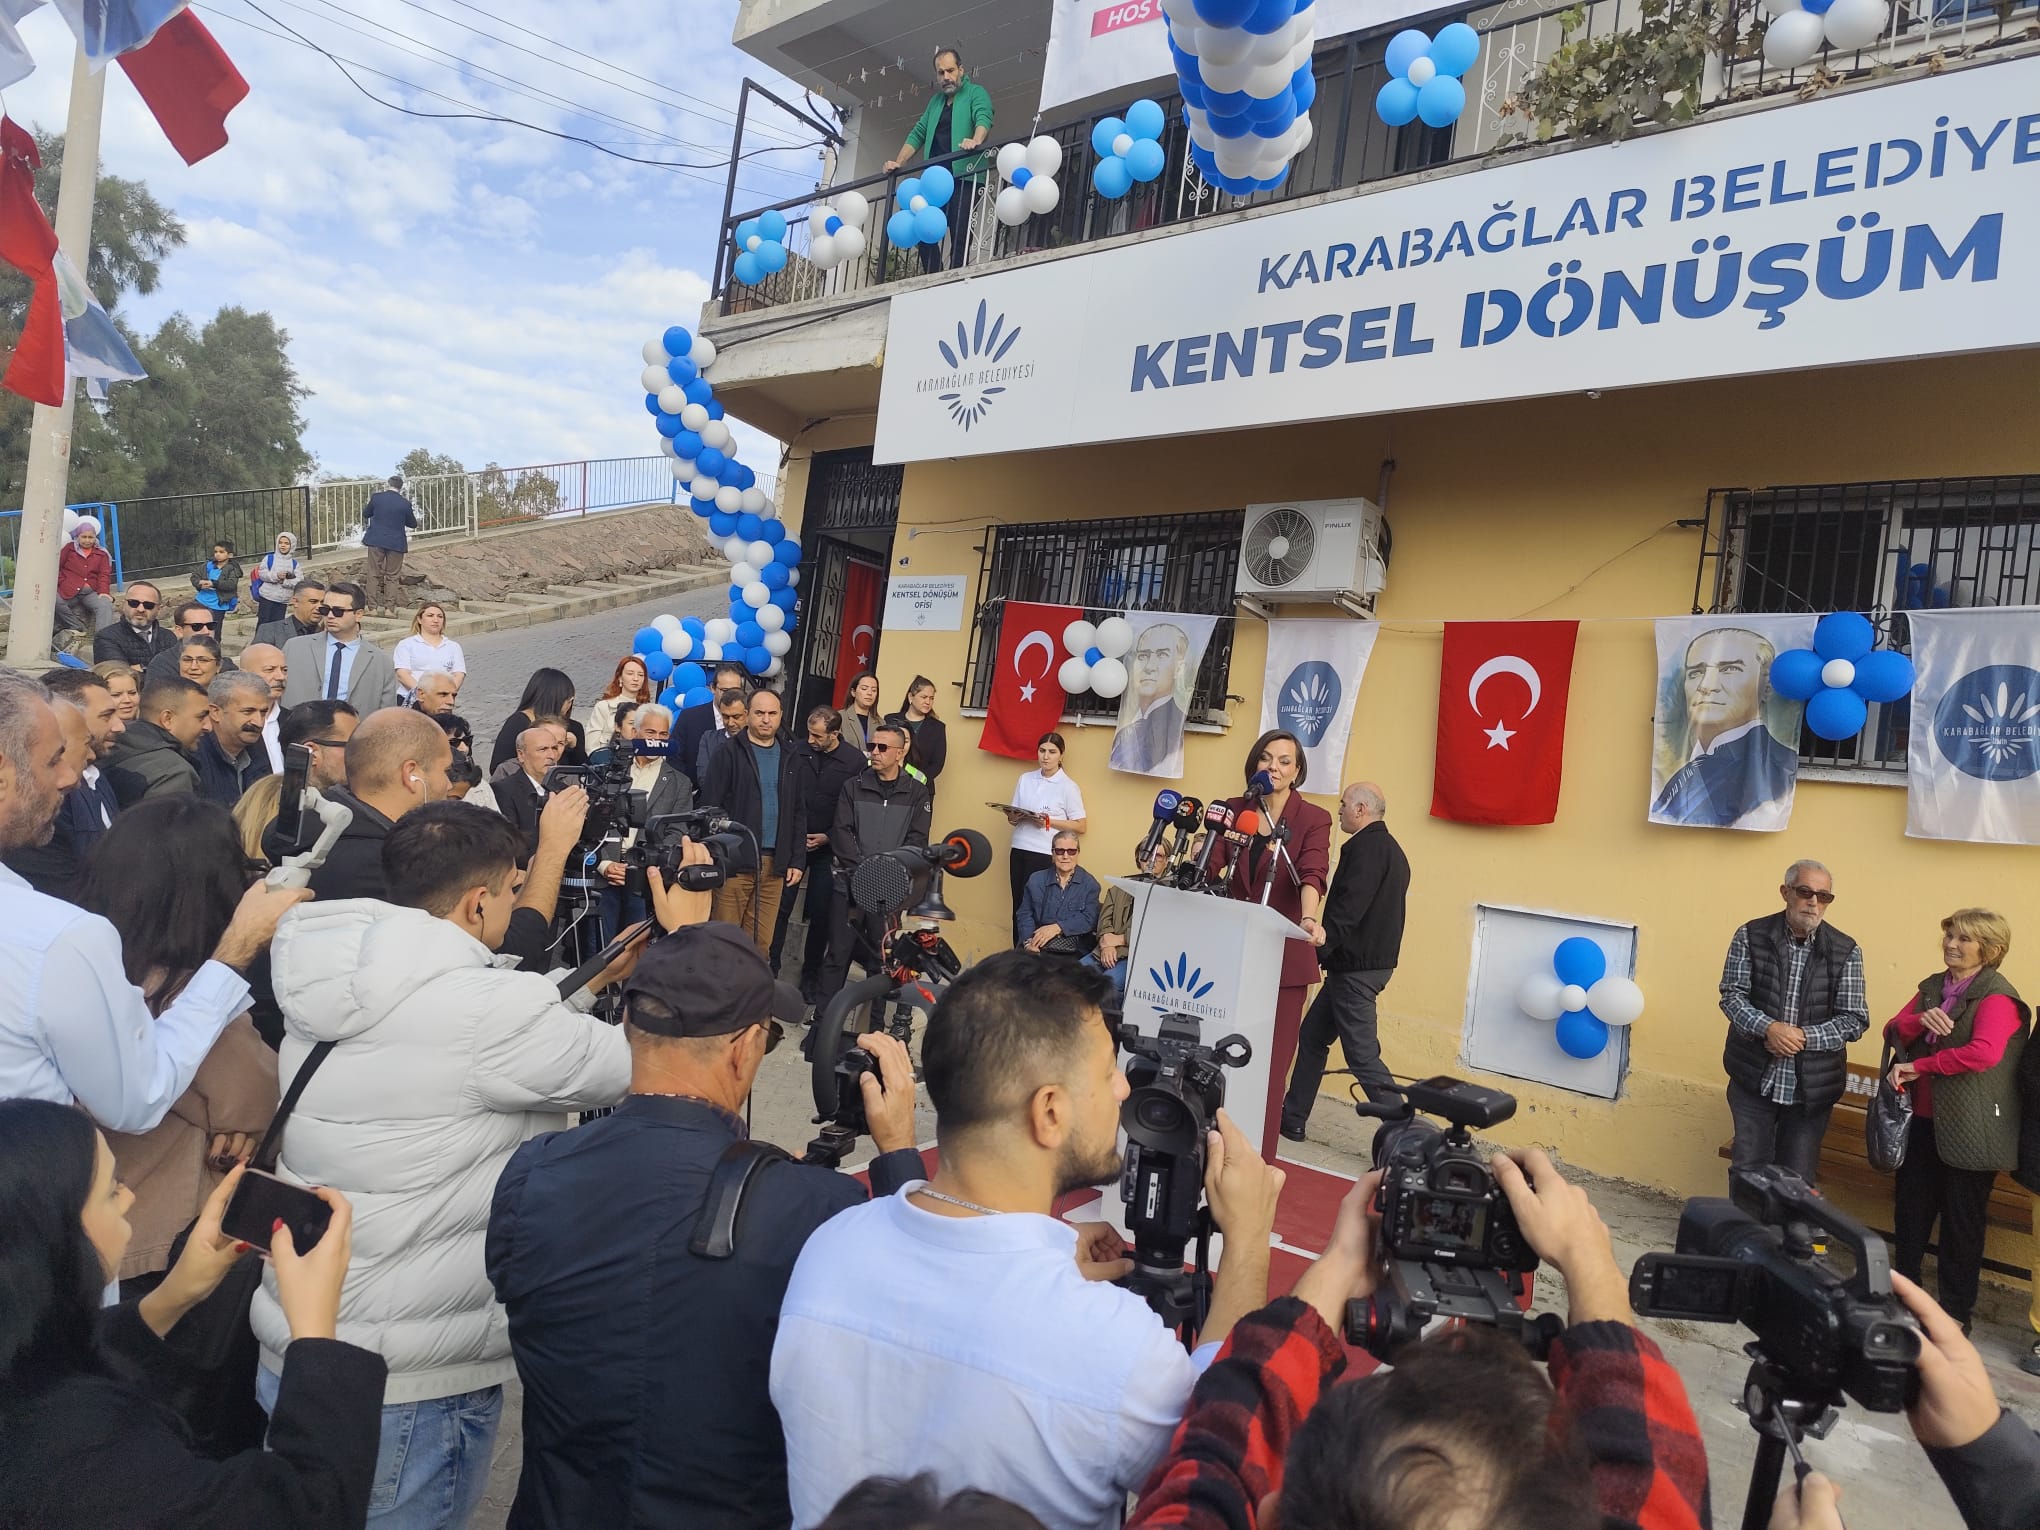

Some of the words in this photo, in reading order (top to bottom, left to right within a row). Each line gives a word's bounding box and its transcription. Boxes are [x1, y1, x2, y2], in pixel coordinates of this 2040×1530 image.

[1258, 188, 1647, 293] KARABAĞLAR
[1130, 302, 1434, 392] KENTSEL
[1459, 211, 2004, 349] DÖNÜŞÜM
[916, 371, 974, 393] KARABAĞLAR
[978, 359, 1035, 385] BELEDİYESİ
[892, 591, 921, 599] KENTSEL
[923, 589, 958, 600] DÖNÜŞÜM
[914, 599, 932, 609] OFİSİ
[1943, 725, 2001, 737] KARABAĞLAR
[1133, 988, 1179, 1008] KARABAĞLAR
[1182, 1000, 1227, 1019] BELEDİYESİ
